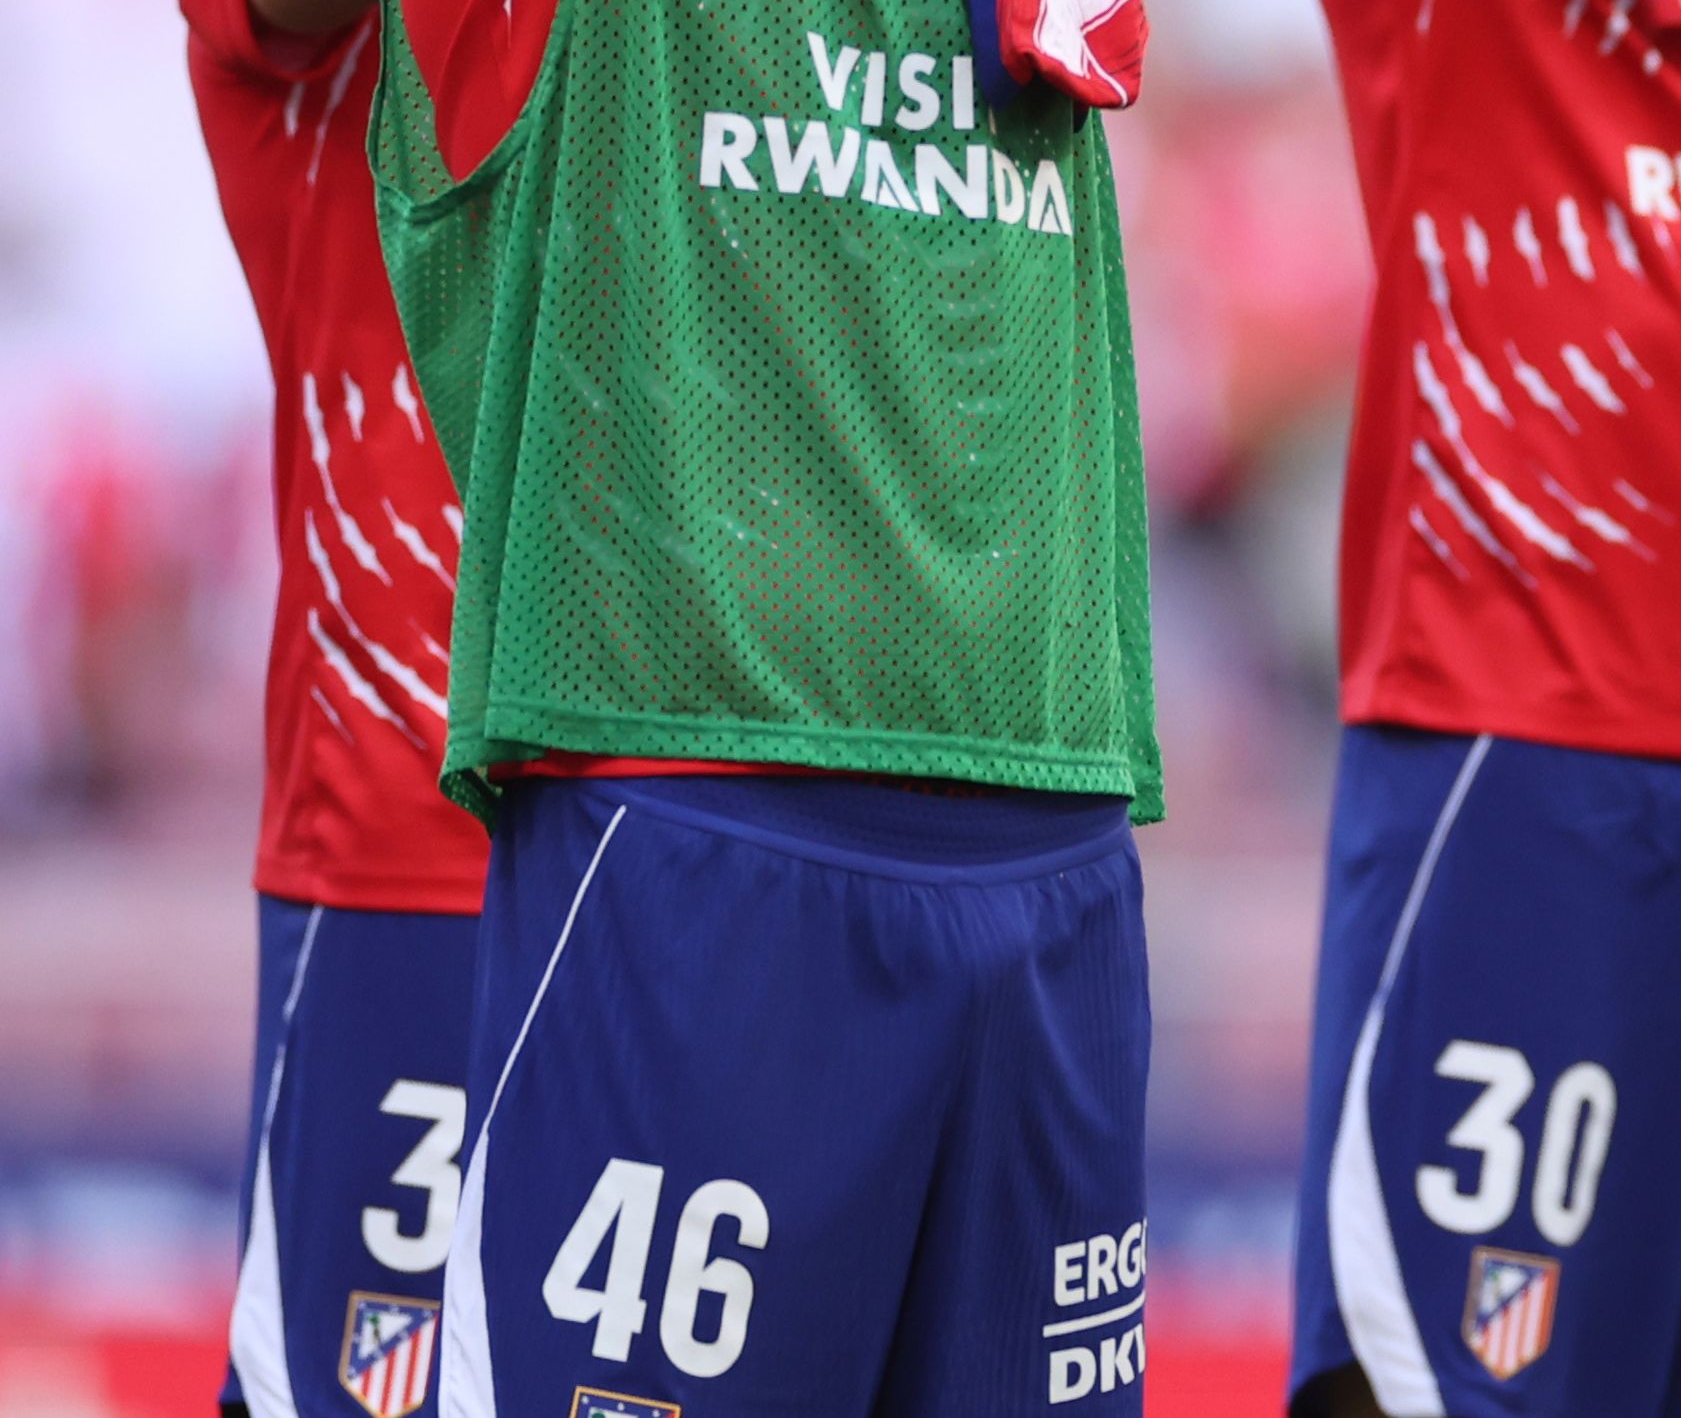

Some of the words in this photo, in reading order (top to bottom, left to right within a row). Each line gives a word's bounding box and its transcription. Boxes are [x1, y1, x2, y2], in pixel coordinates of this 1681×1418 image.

[806, 30, 977, 132] VISI
[699, 110, 1073, 237] RWANDA
[1415, 1038, 1618, 1248] 30
[541, 1157, 770, 1379] 46
[1053, 1216, 1148, 1308] ERG
